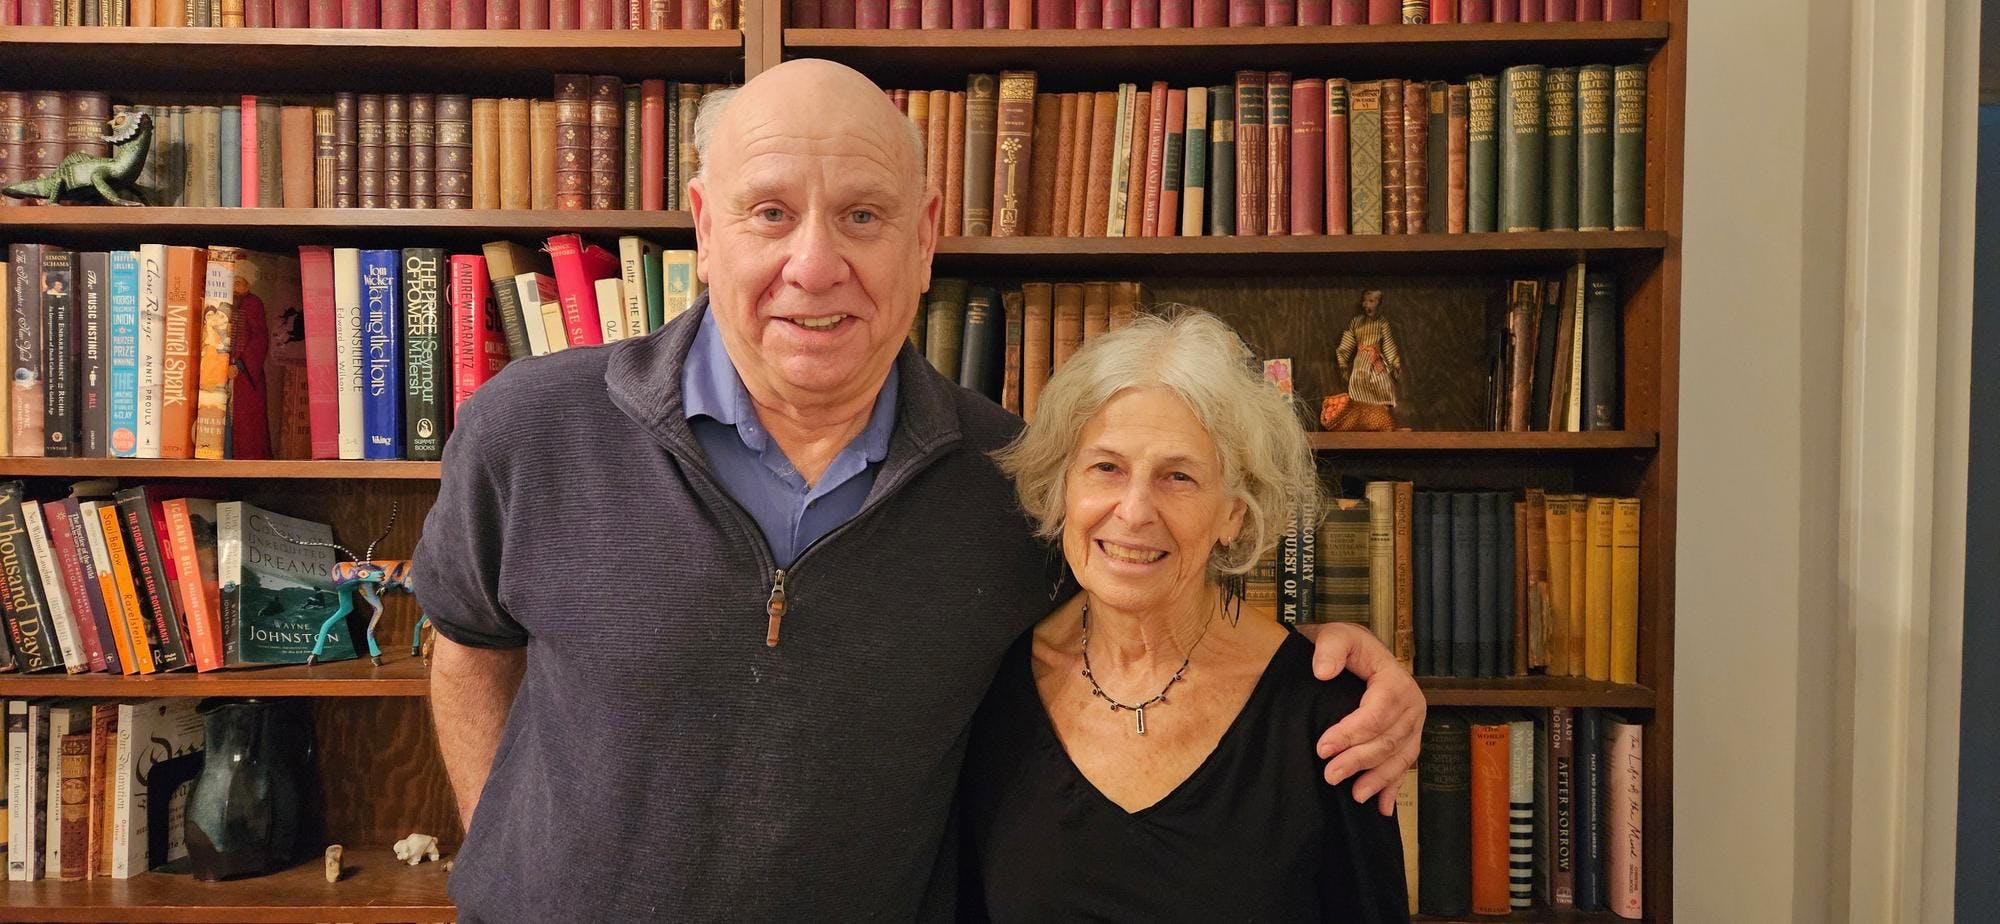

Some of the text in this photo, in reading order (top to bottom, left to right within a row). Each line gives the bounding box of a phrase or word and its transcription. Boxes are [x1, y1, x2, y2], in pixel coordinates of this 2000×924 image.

[1511, 72, 1541, 81] HENRIK
[1579, 72, 1610, 81] HENRIK
[1153, 118, 1161, 134] THE
[1151, 136, 1160, 165] WORLD
[1146, 200, 1156, 223] WEST
[113, 296, 135, 304] YIDDISH
[141, 258, 160, 342] Close Range
[626, 260, 639, 316] Fultz THE
[87, 270, 97, 360] The MUSIC INSTINCT
[113, 314, 134, 326] UNION
[336, 308, 345, 342] Edward
[461, 262, 474, 369] ANDREW MARANTZ
[499, 288, 522, 347] REMBRANDT
[566, 294, 580, 324] THE
[17, 318, 31, 340] New
[114, 346, 134, 356] PRIZE
[163, 304, 188, 406] Muriel Spark
[350, 306, 363, 392] CONSILIENCE
[113, 372, 134, 390] THE
[417, 340, 438, 404] Seymour
[120, 411, 134, 419] CLAY
[372, 436, 392, 446] Viking
[28, 512, 52, 586] Not Without Laughter
[102, 513, 122, 566] Saul Bellow
[128, 512, 138, 524] THE
[140, 552, 150, 565] LIFE
[171, 502, 192, 576] ICELAND'S BELL
[86, 564, 95, 580] Wild
[250, 546, 328, 578] DREAMS
[2, 514, 42, 668] Thousand Days
[1284, 580, 1297, 598] OF
[123, 594, 142, 646] Ravelstein
[274, 618, 310, 630] WAYNE
[1552, 709, 1561, 749] BORTON
[14, 782, 22, 818] American
[1627, 735, 1642, 859] The Life of the Mind
[1558, 761, 1570, 870] AFTER SORROW
